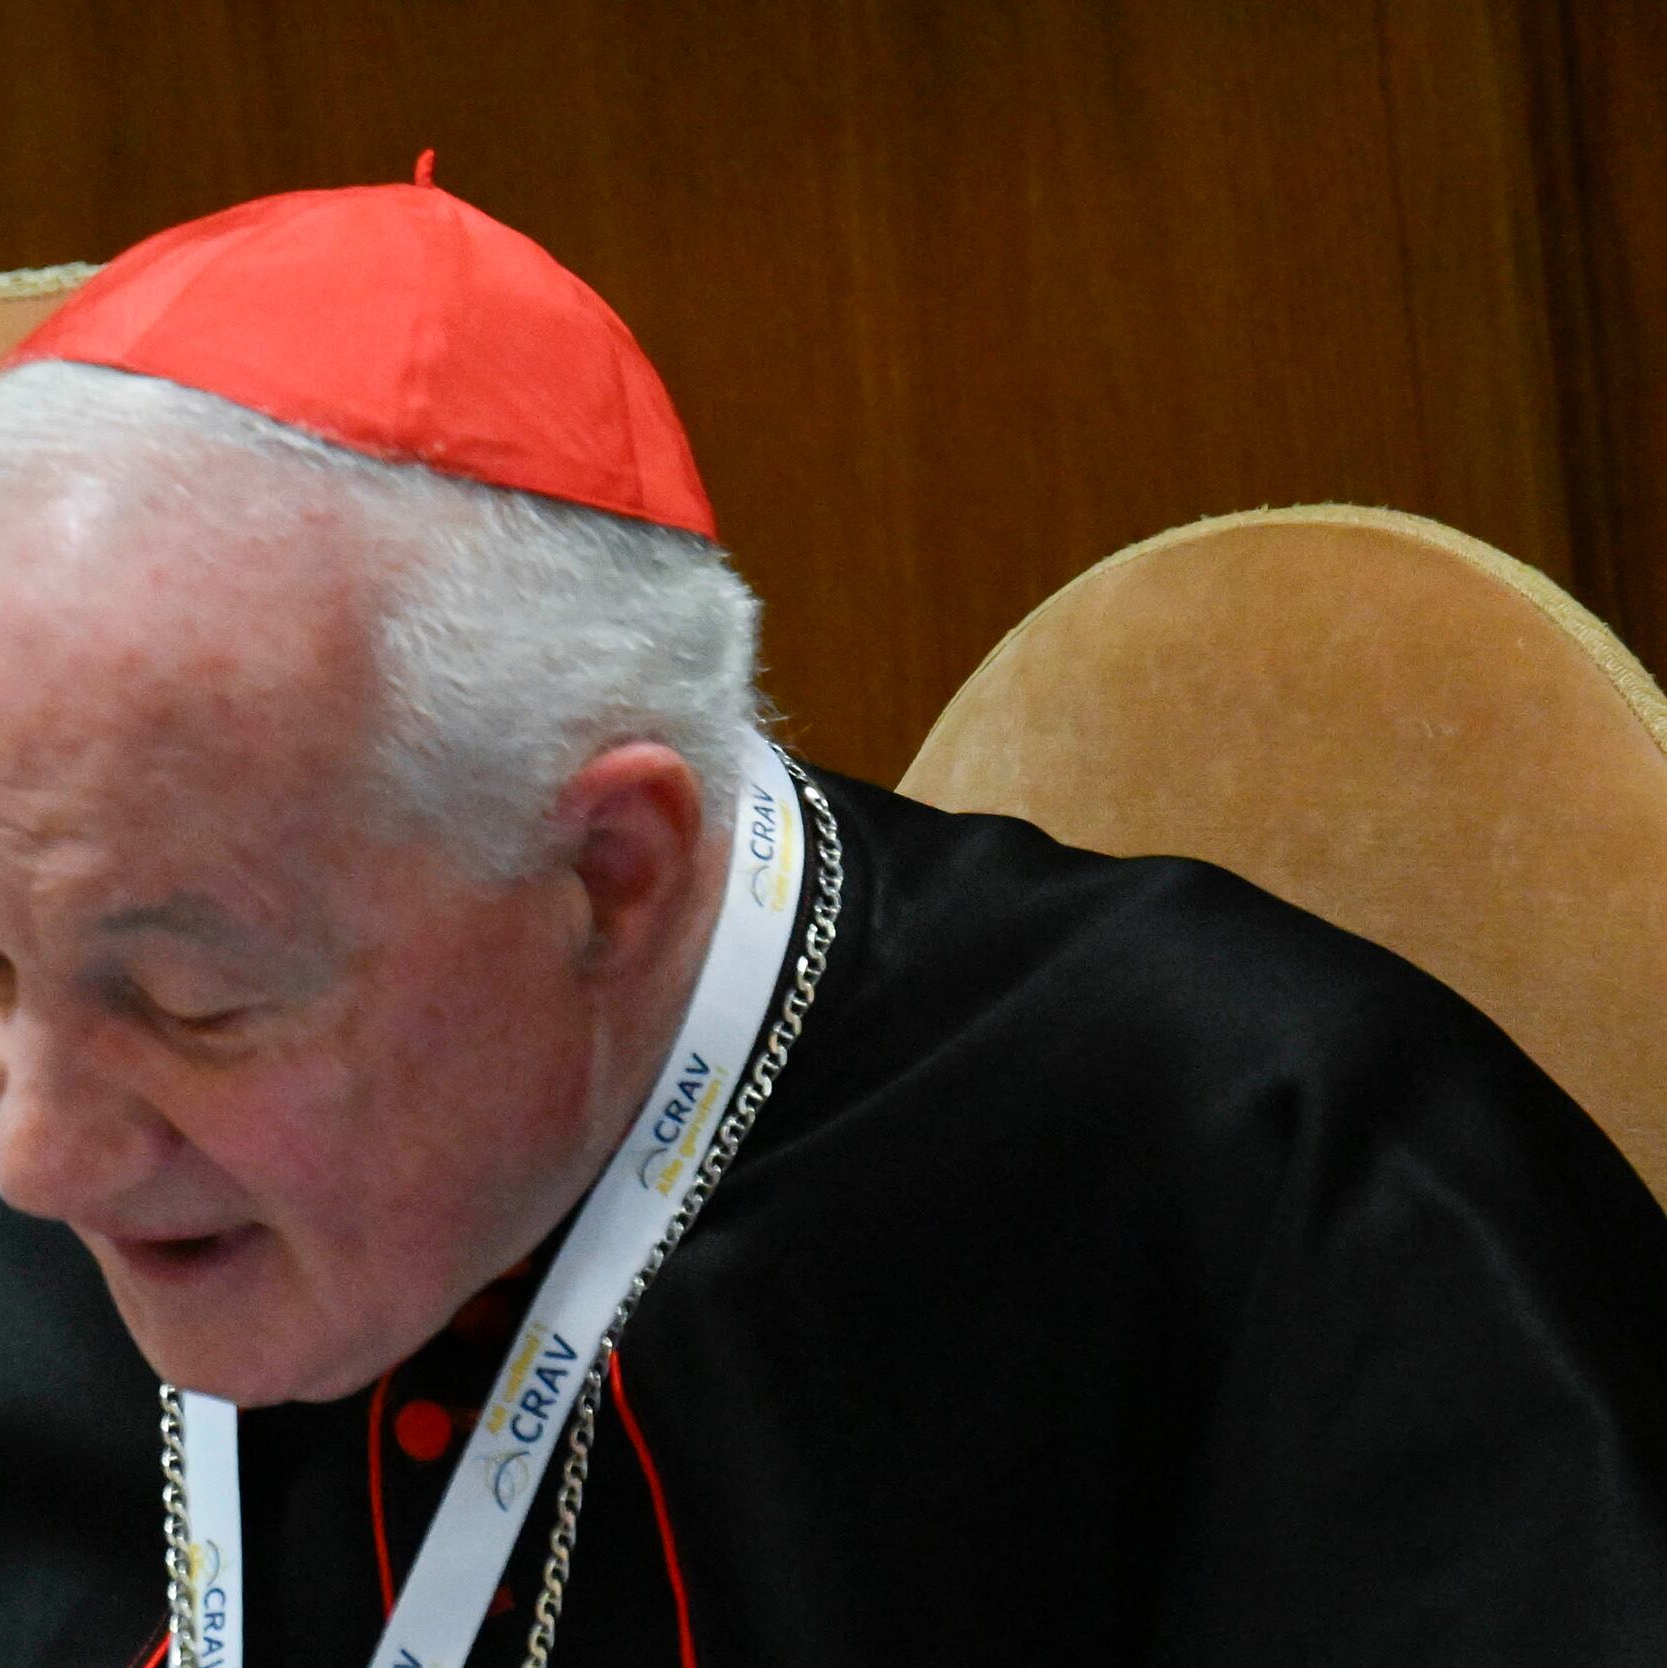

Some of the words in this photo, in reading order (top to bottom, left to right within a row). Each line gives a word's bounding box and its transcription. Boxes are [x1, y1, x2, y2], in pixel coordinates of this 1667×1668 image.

[751, 784, 776, 862] CRAV
[654, 1052, 710, 1143] CRAV
[510, 1333, 577, 1442] CRAV
